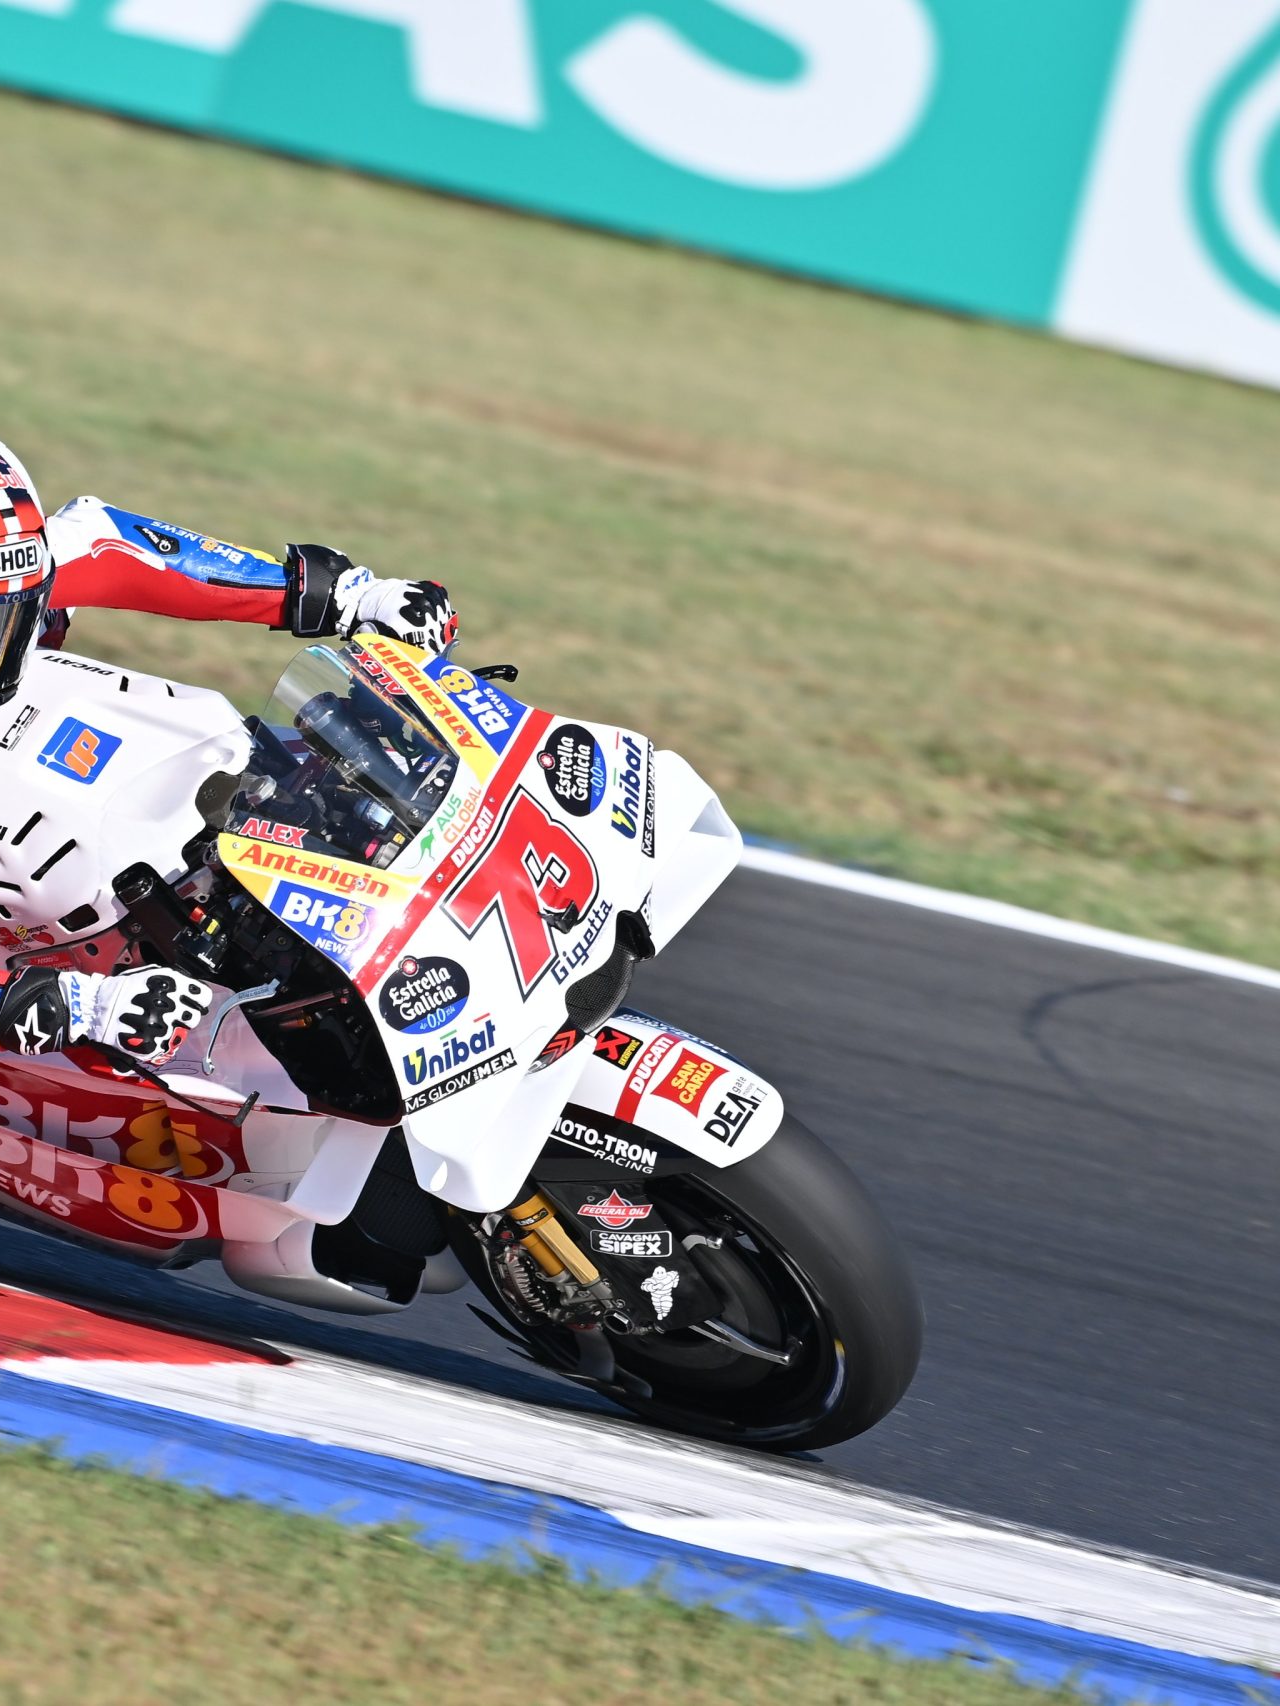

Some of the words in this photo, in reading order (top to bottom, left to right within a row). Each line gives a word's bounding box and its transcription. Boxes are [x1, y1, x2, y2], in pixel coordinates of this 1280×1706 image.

[4, 592, 29, 604] YOU
[41, 655, 115, 676] DUCATI
[351, 650, 408, 695] ALEX
[372, 642, 482, 749] Antangin
[438, 665, 510, 735] BK8
[483, 688, 512, 718] NEWS
[555, 736, 574, 800] Estrella
[571, 743, 591, 801] Galicia
[611, 735, 642, 840] Unibat
[238, 817, 310, 849] ALEX
[436, 793, 462, 831] AUS
[443, 786, 482, 844] GLOBAL
[450, 805, 495, 869] DUCATI
[238, 843, 389, 898] Antangin
[442, 787, 598, 1001] 73
[281, 891, 368, 943] BK8
[315, 937, 353, 956] NEWS
[551, 900, 613, 986] Gigetta
[71, 975, 84, 1026] ALEX
[389, 967, 452, 1007] Estrella
[400, 985, 458, 1021] Galicia
[402, 1019, 496, 1086] Unibat
[628, 1036, 675, 1095] DUCATI
[671, 1060, 699, 1090] SAN
[405, 1094, 427, 1113] MS
[428, 1072, 471, 1102] GLOW
[478, 1051, 515, 1079] MEN
[679, 1061, 715, 1104] CARLO
[594, 1149, 655, 1175] RACING
[582, 1206, 627, 1216] FEDERAL
[628, 1206, 646, 1216] OIL
[598, 1232, 662, 1242] CAVAGNA
[598, 1239, 662, 1255] SIPEX
